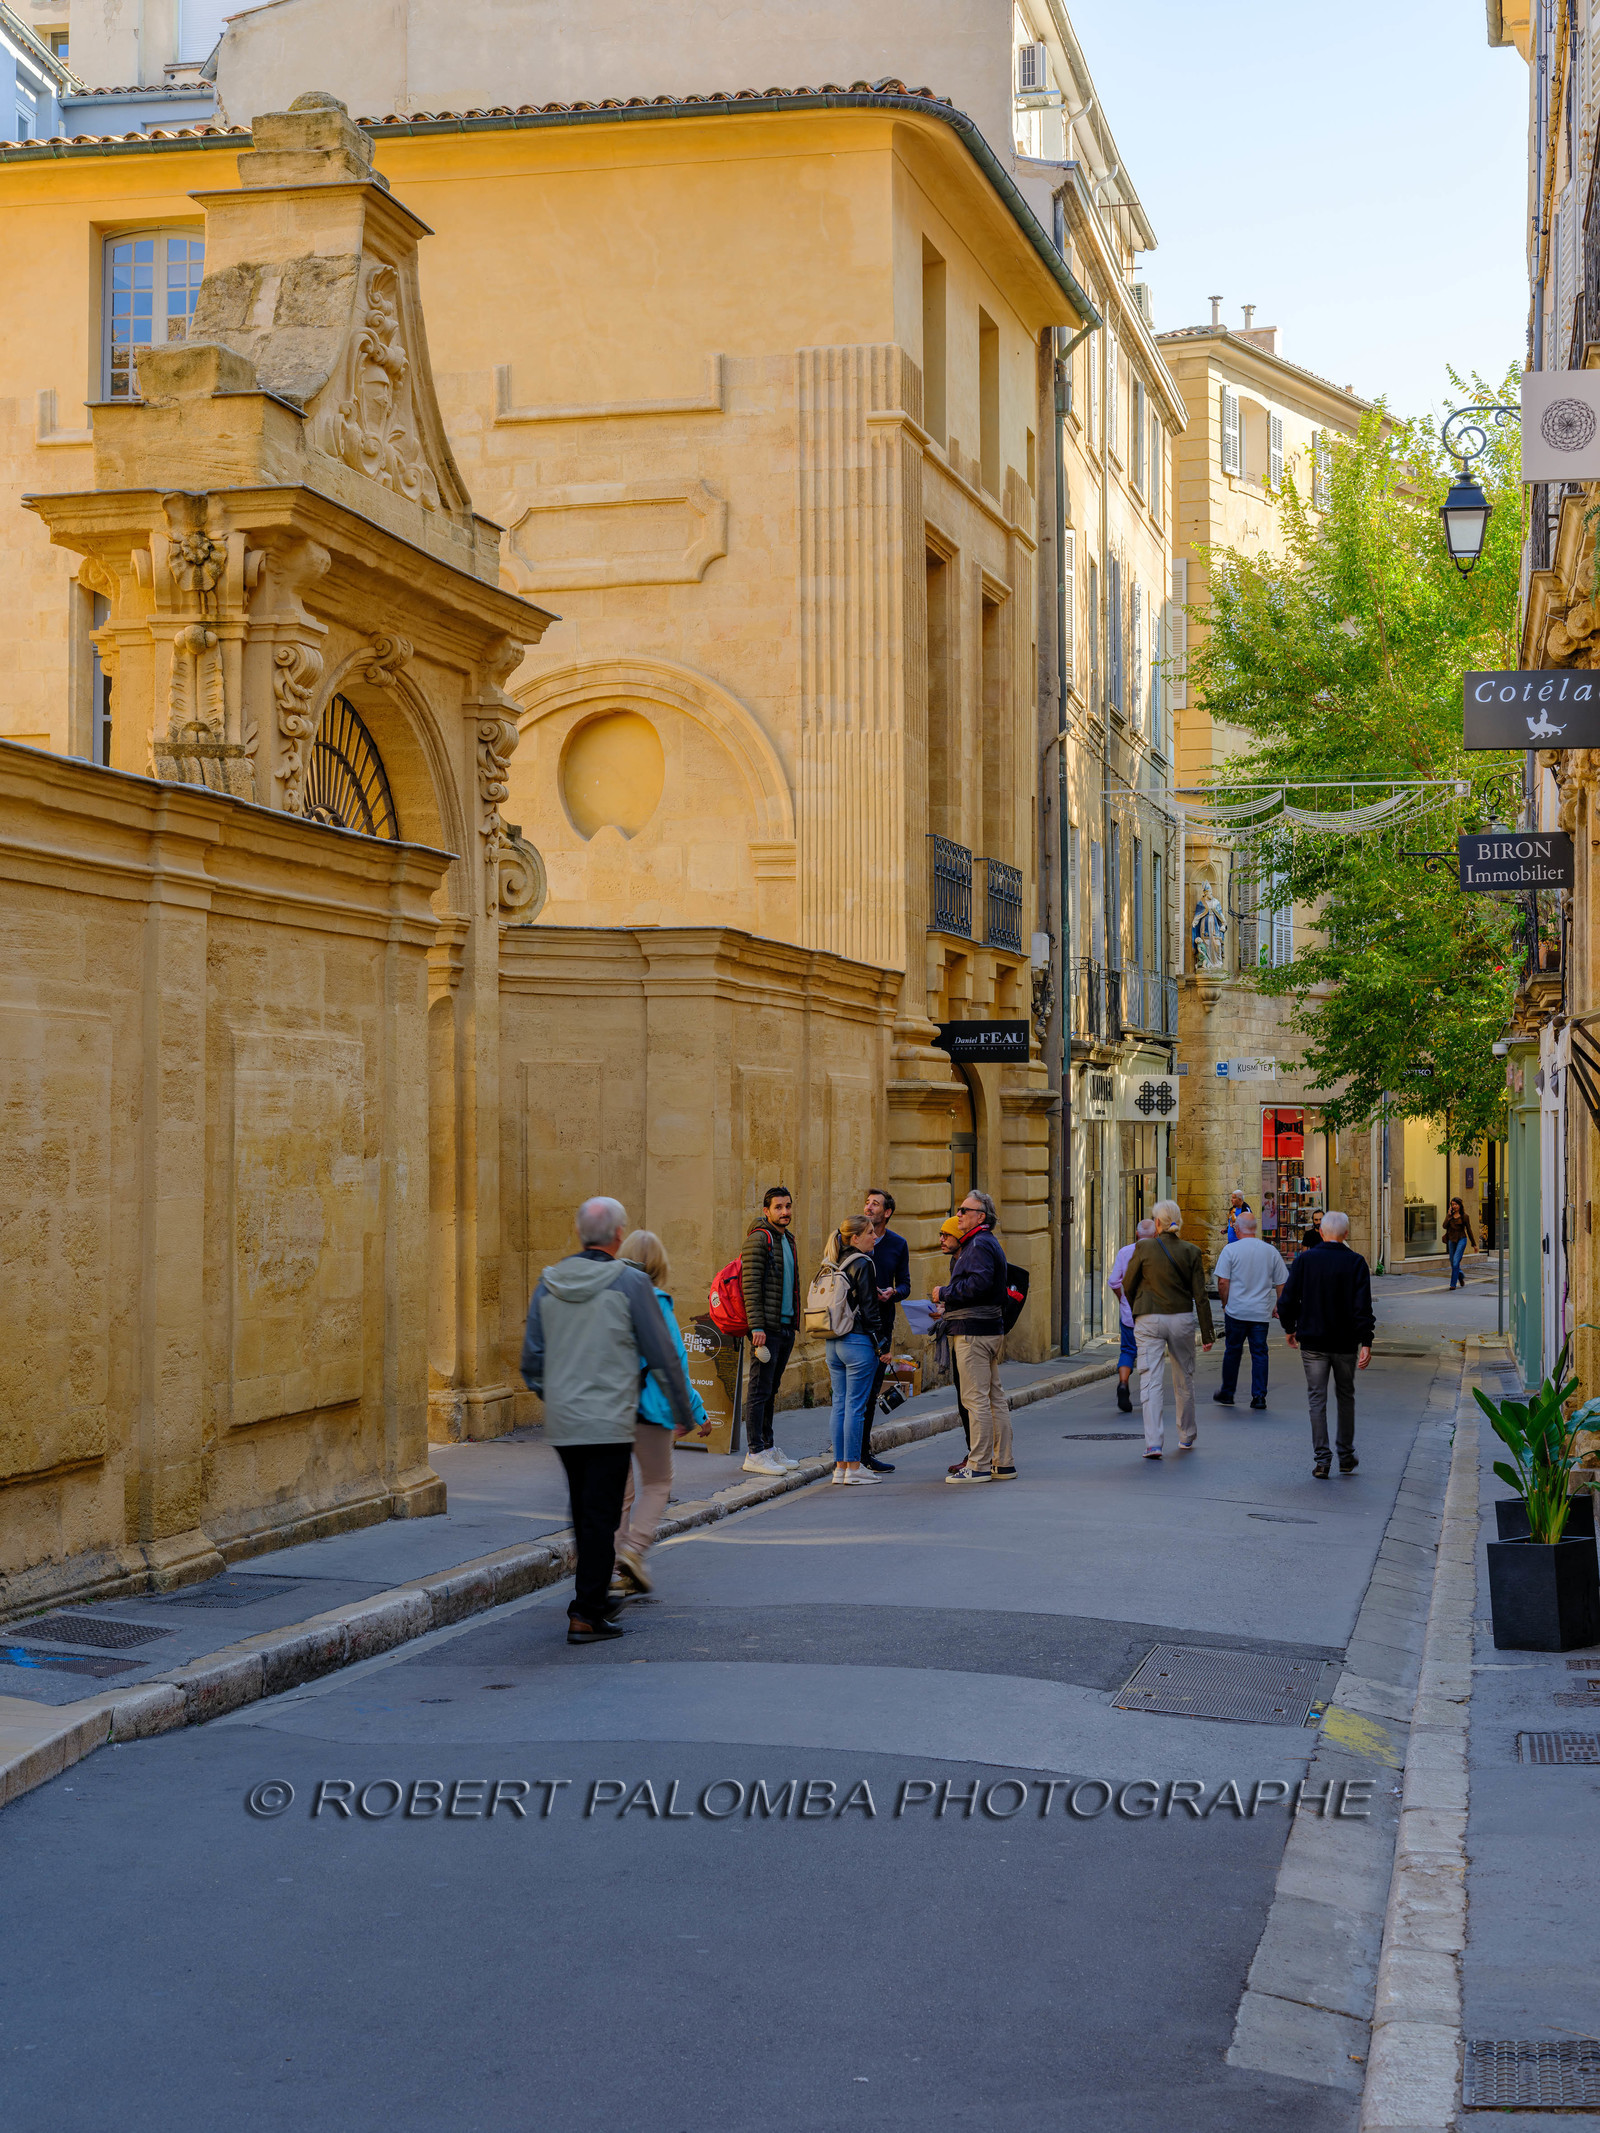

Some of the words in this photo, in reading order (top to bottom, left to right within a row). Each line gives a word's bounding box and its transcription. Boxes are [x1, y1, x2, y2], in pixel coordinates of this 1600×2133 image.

[1474, 677, 1600, 703] Cotéla
[1477, 840, 1552, 861] BIRON
[1466, 864, 1565, 884] Immobilier
[954, 1036, 978, 1044] Daniel
[979, 1031, 1025, 1044] FEAU
[1237, 1063, 1259, 1073] KUSMI
[1260, 1063, 1273, 1073] TEA
[683, 1332, 712, 1345] Pilates
[683, 1342, 706, 1353] Club
